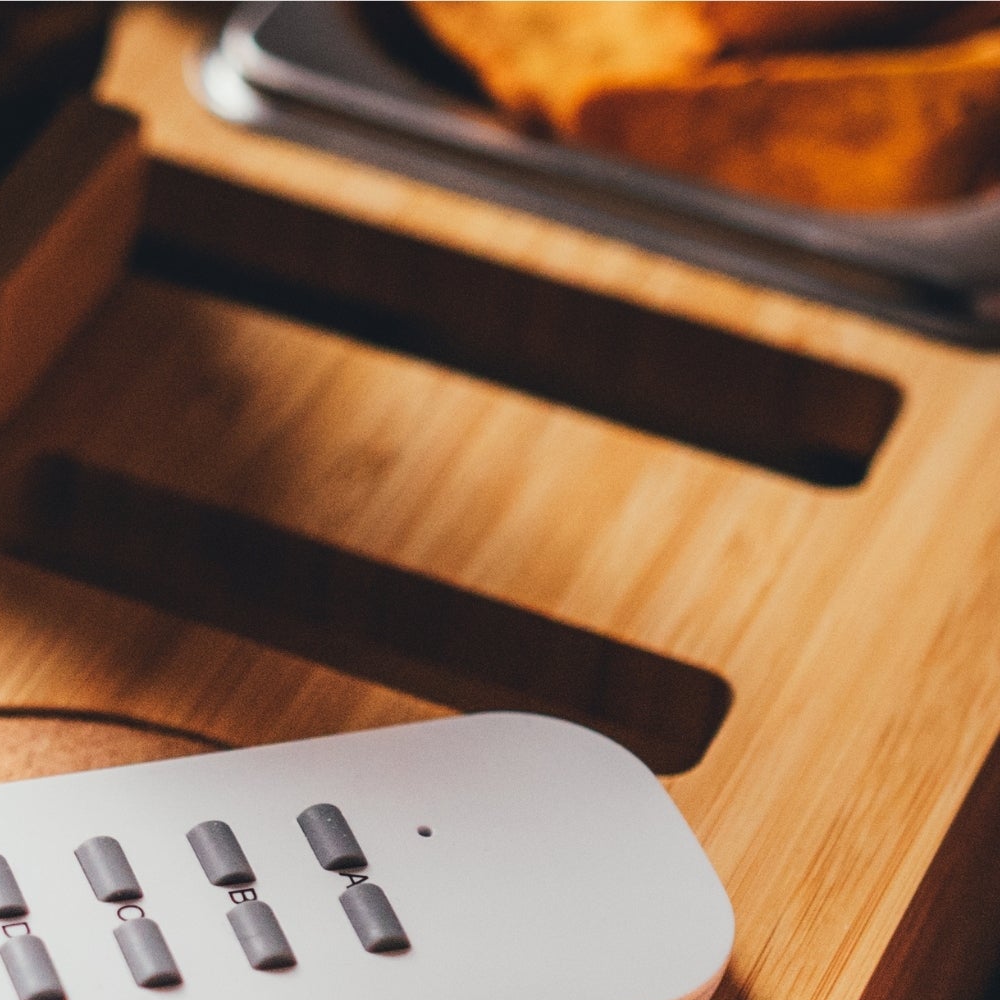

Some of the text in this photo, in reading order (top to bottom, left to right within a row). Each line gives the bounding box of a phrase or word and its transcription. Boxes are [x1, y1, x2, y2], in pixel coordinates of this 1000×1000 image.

[339, 872, 369, 888] A
[228, 887, 257, 904] B
[117, 904, 145, 921] C
[2, 921, 31, 938] D
